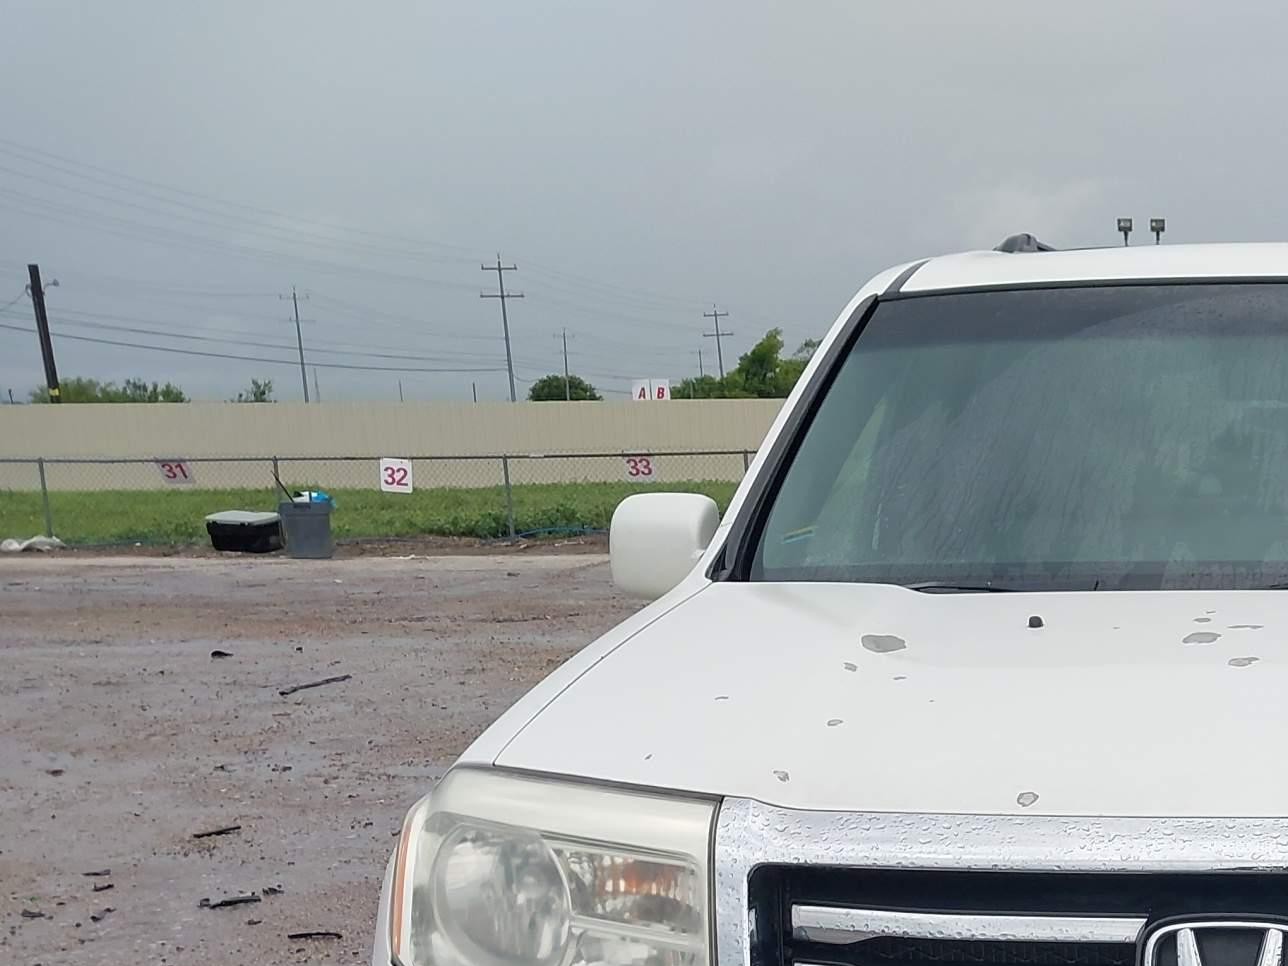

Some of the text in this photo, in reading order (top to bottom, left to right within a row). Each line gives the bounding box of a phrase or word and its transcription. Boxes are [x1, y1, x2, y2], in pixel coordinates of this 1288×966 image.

[638, 386, 646, 399] A
[656, 386, 665, 399] B
[161, 463, 188, 479] 31
[626, 458, 652, 477] 33
[383, 466, 409, 487] 32
